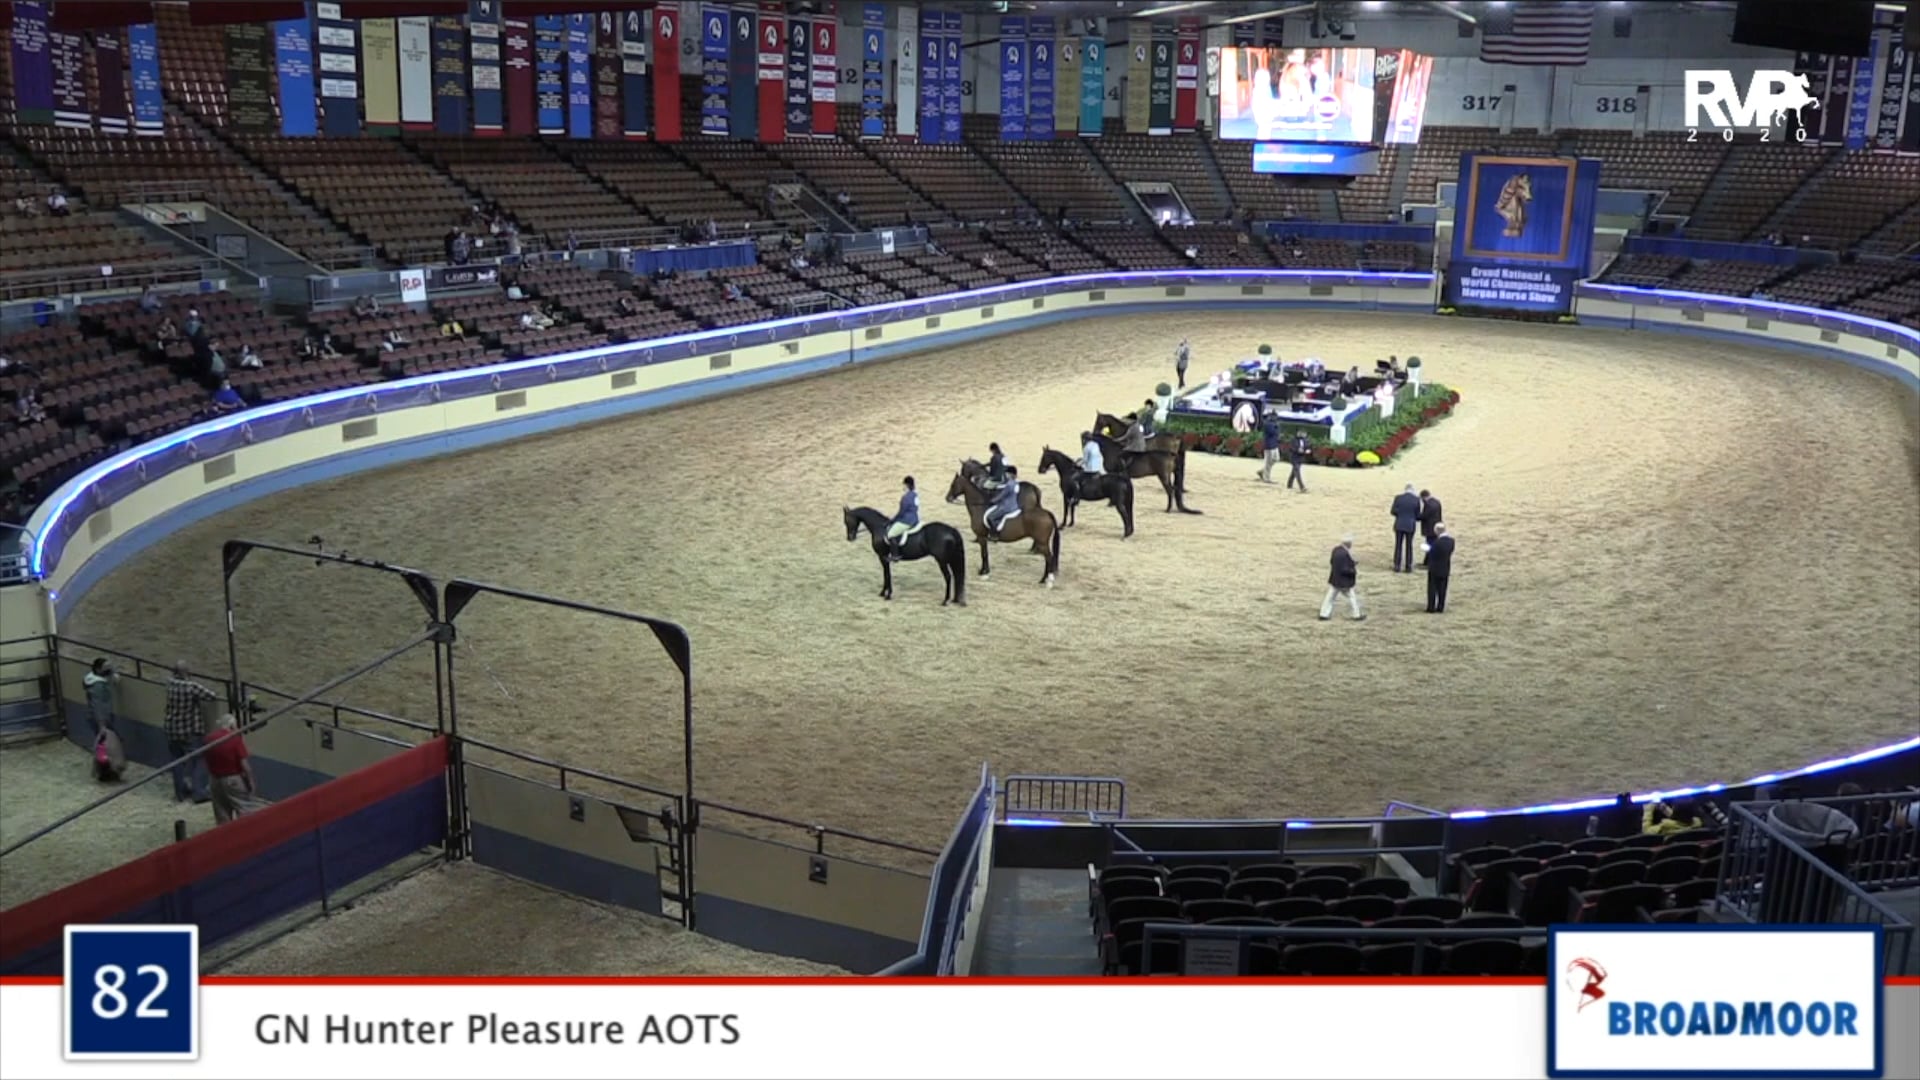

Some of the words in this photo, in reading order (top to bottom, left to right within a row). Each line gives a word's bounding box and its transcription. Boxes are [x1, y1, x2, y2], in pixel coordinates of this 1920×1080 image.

[1462, 95, 1502, 111] 317
[1596, 97, 1637, 113] 318
[1472, 268, 1500, 278] Grand
[1502, 269, 1543, 281] National
[1544, 273, 1551, 282] &
[1460, 277, 1489, 288] World
[1490, 278, 1561, 294] Championship
[1461, 287, 1498, 300] Morgan
[1499, 290, 1528, 301] Horse
